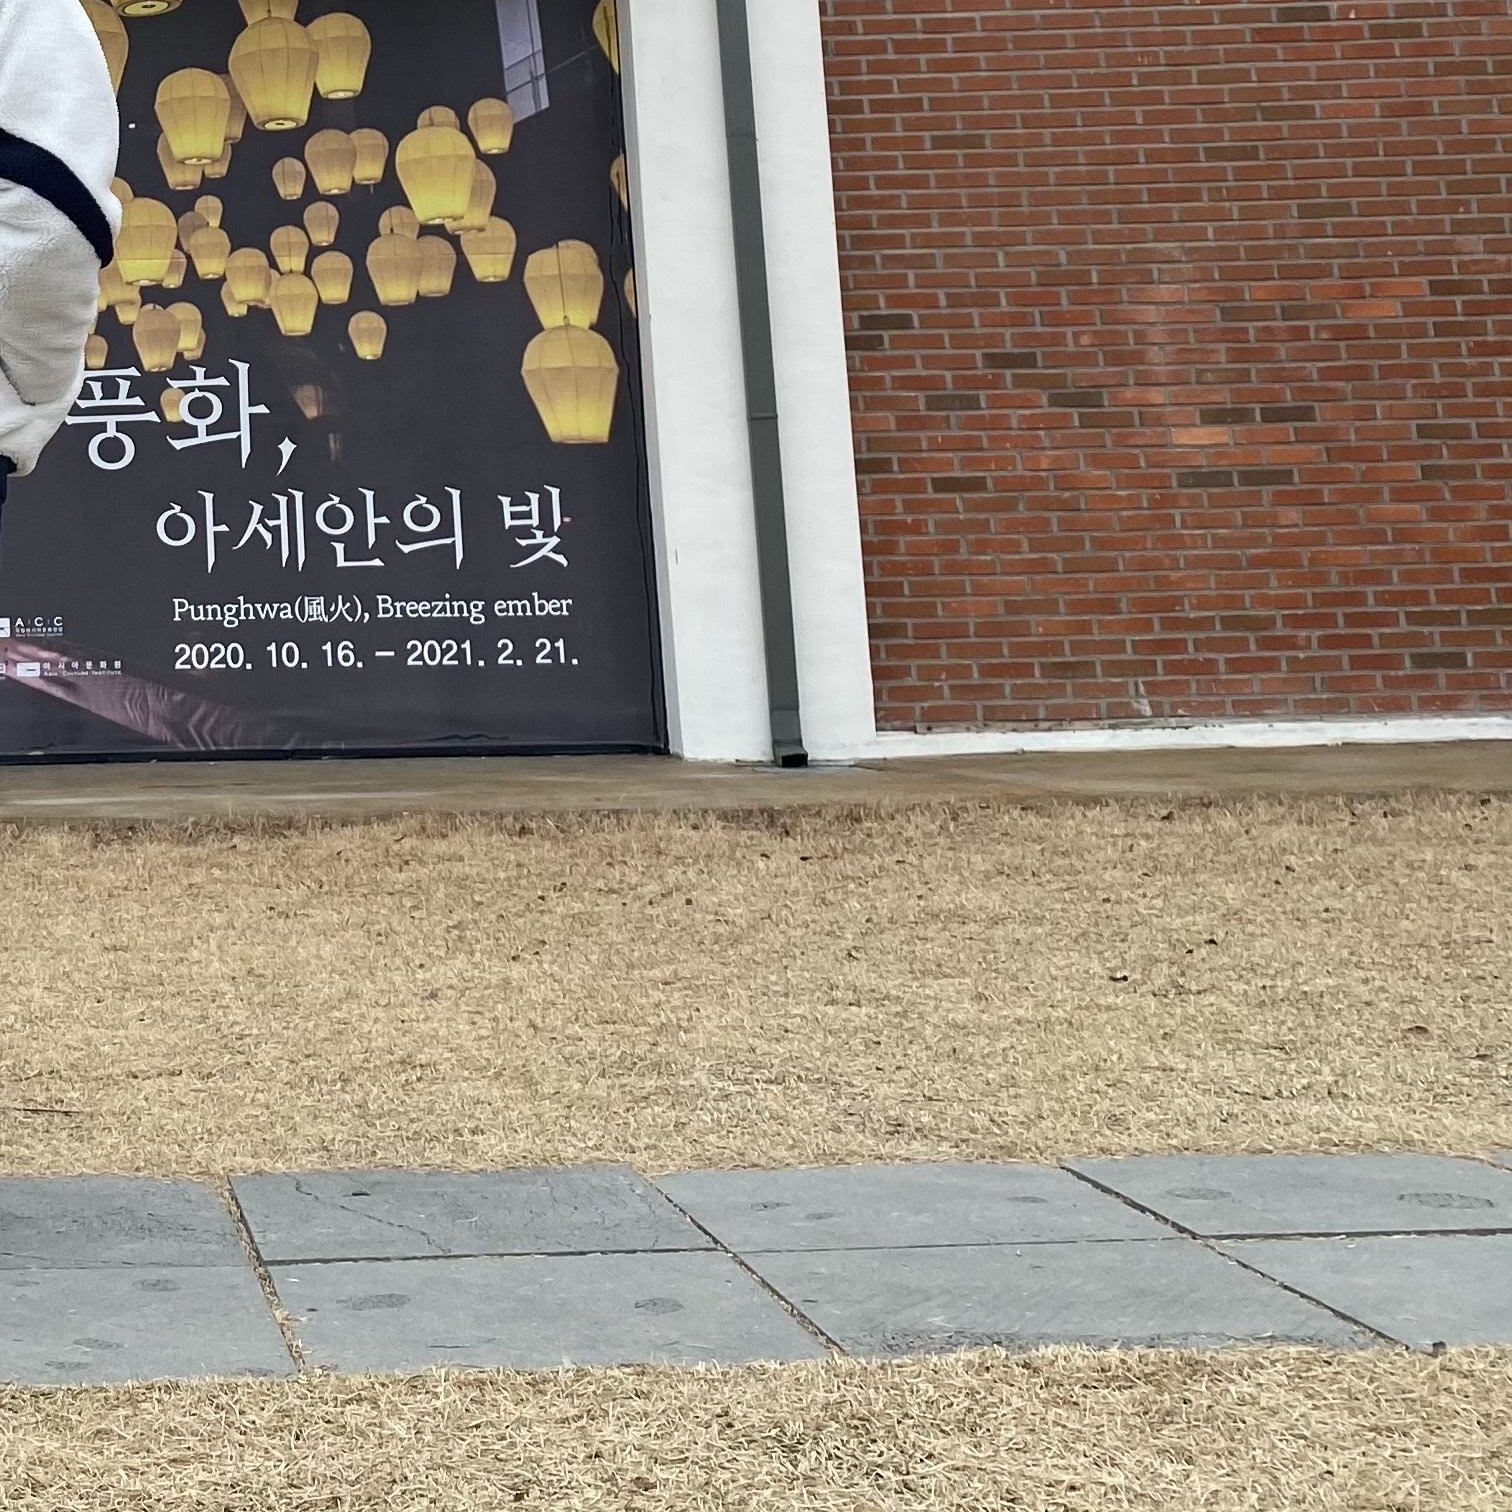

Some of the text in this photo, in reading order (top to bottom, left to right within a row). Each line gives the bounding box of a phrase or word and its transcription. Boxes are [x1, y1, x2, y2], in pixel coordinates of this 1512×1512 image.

[65, 359, 297, 476] 풍화,
[156, 484, 568, 573] 아세안의 빛
[172, 592, 573, 628] Punghwa(風火), Breezing ember
[174, 642, 252, 670] 2020.
[266, 640, 308, 670] 10.
[321, 640, 363, 668] 16.
[406, 639, 485, 667] 2021.
[497, 638, 523, 667] 2.
[535, 638, 579, 666] 21.
